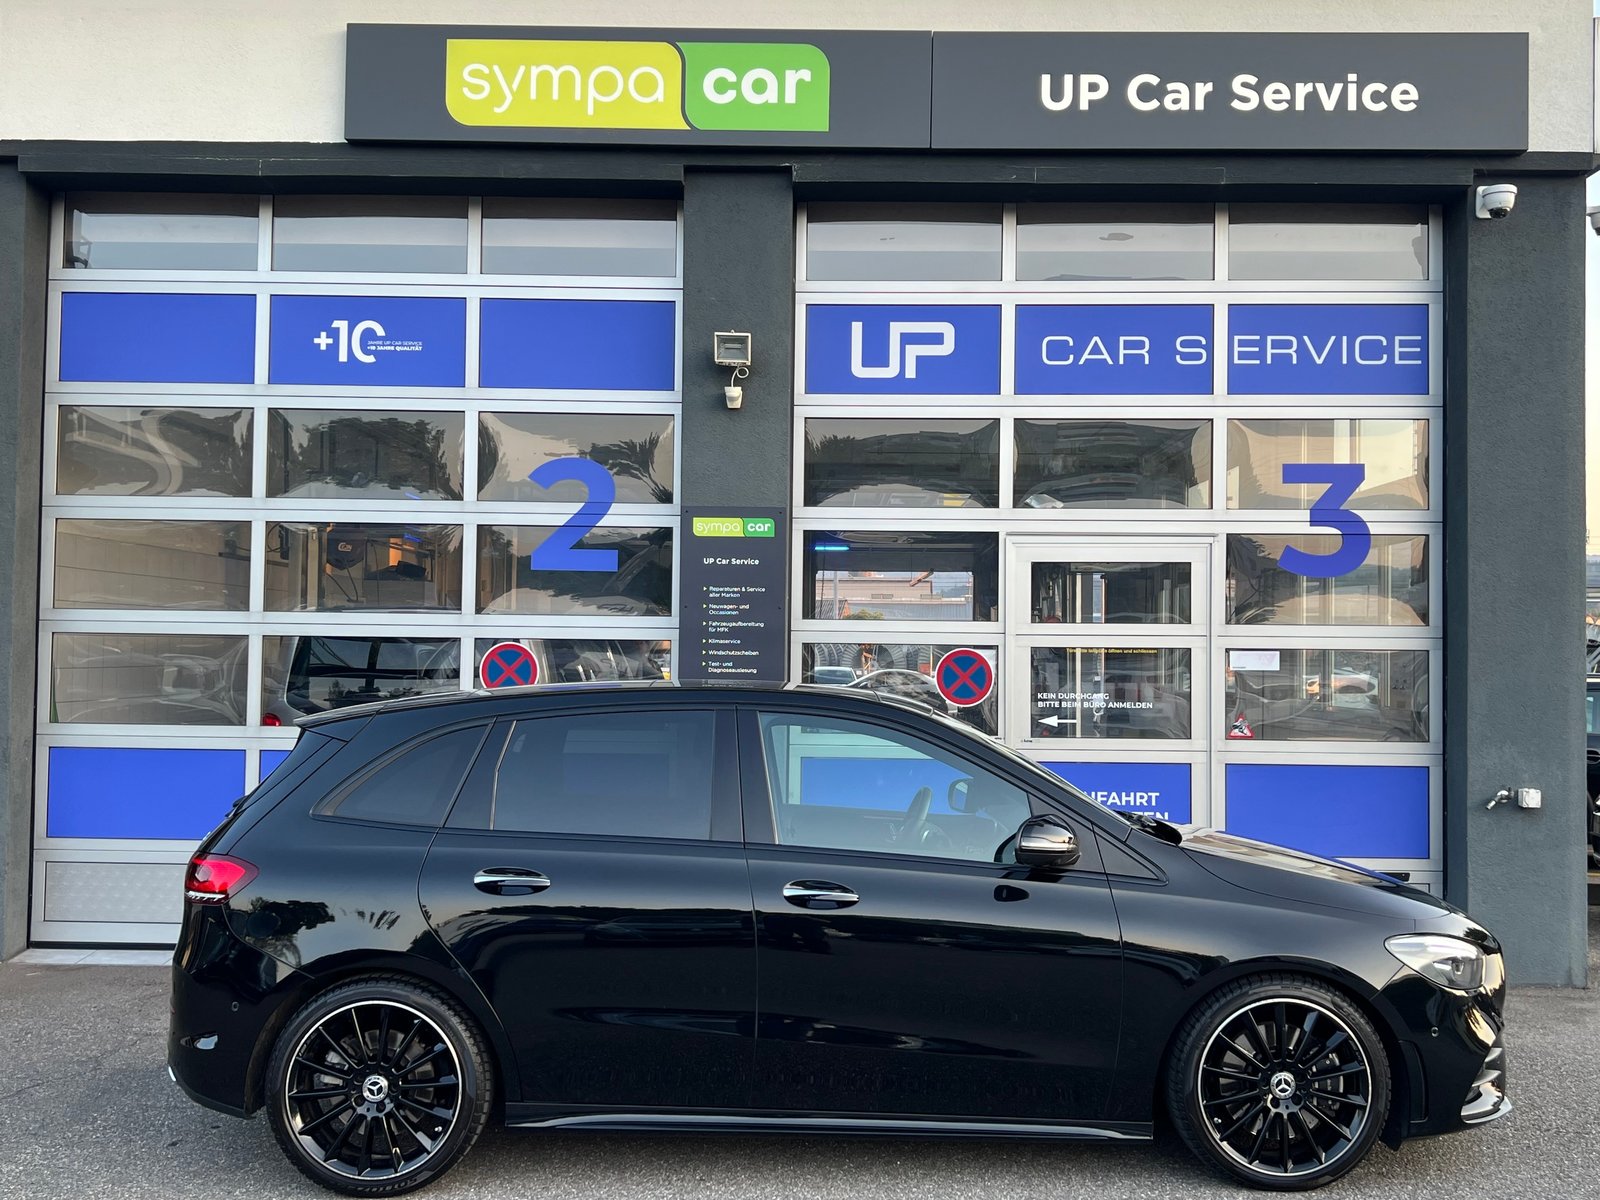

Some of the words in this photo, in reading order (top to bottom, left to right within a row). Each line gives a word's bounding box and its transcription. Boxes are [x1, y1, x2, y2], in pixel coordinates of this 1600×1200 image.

[461, 62, 665, 116] sympa
[702, 67, 812, 105] car
[1040, 73, 1110, 112] UP
[1126, 73, 1213, 112] Car
[1230, 73, 1420, 112] Service
[850, 321, 956, 379] UP
[1041, 335, 1151, 366] CAR
[528, 456, 619, 572] 2
[696, 522, 740, 534] sympa
[747, 522, 771, 532] car
[1277, 463, 1372, 579] 3
[703, 557, 715, 565] UP
[716, 557, 730, 565] Car
[731, 557, 760, 566] Service
[1037, 692, 1056, 700] KEIN
[1058, 692, 1110, 700] DURCHGANG
[1083, 700, 1107, 708] BÜRO
[1107, 701, 1154, 709] ANMELDEN
